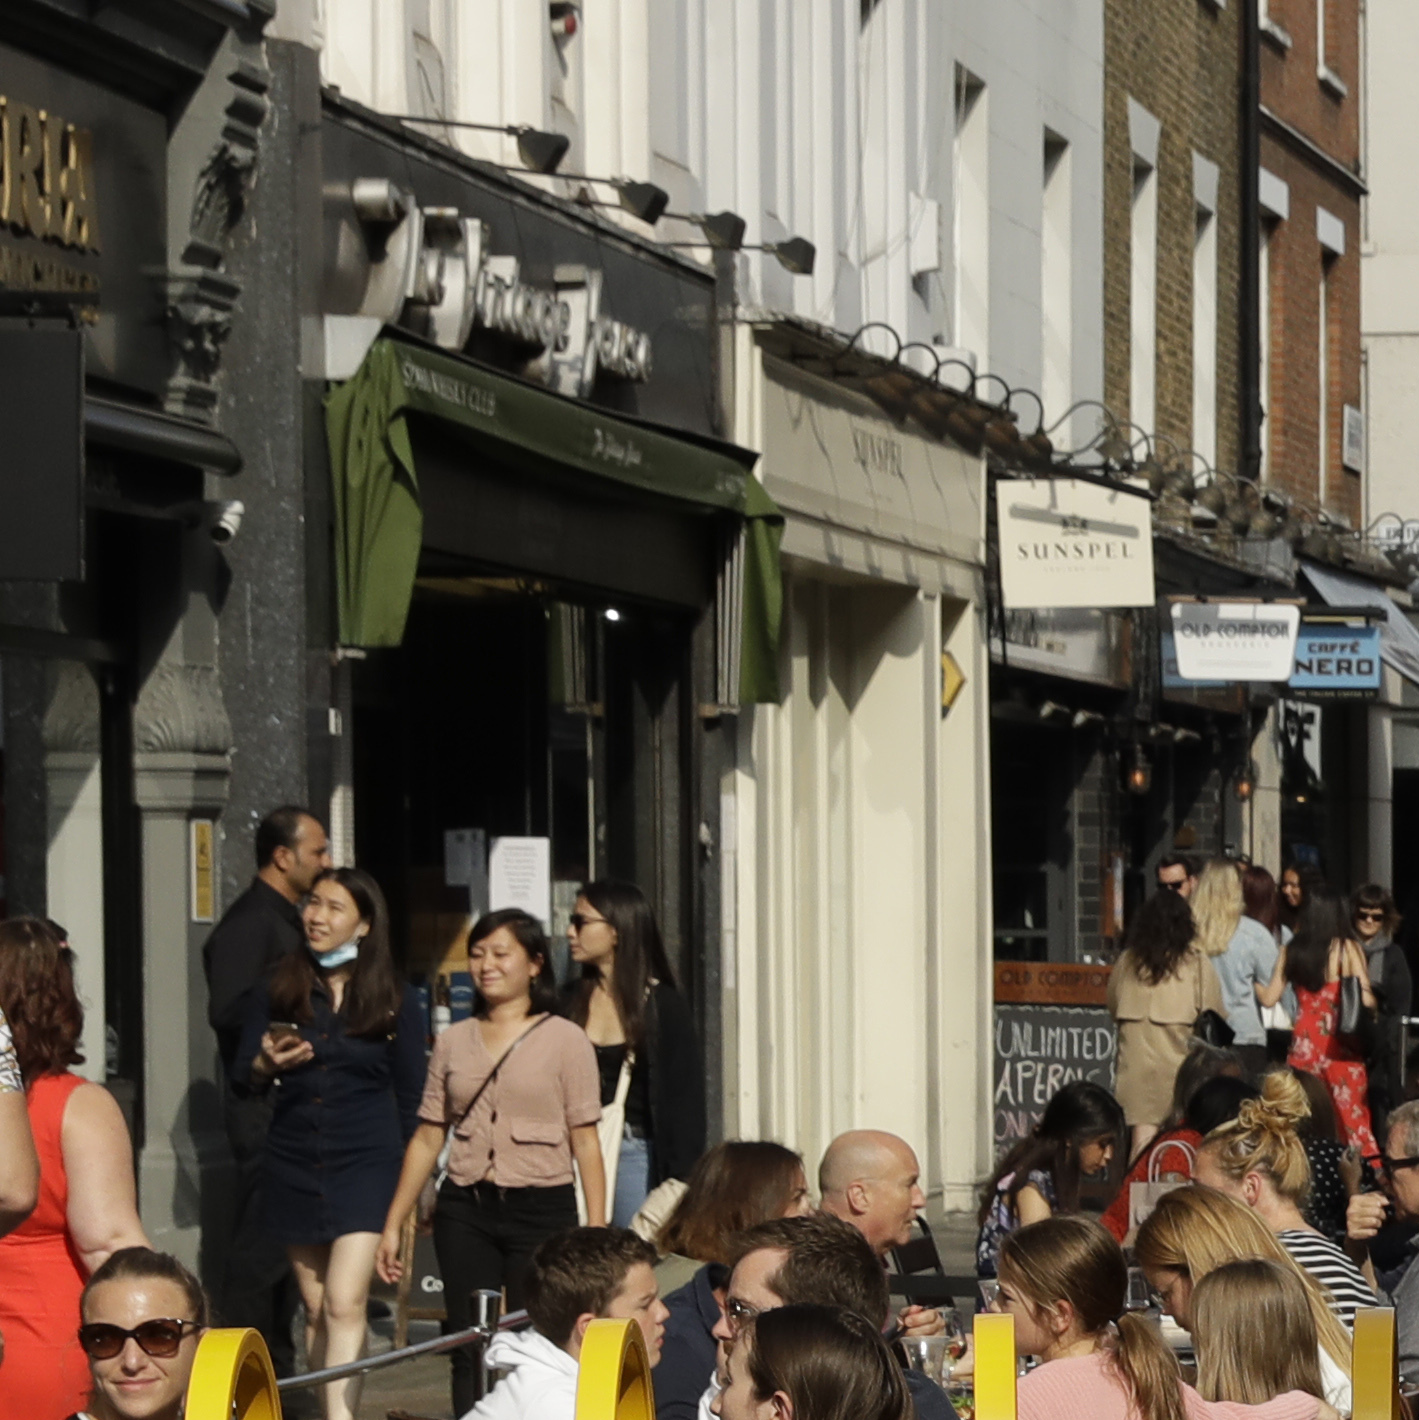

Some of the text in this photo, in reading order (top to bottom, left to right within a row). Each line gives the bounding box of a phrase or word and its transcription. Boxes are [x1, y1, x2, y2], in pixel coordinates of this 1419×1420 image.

[1017, 541, 1134, 560] SUNSPEL
[1181, 621, 1290, 639] OLD COMPTON
[1295, 658, 1374, 676] NERO
[1001, 970, 1033, 985] OLD
[996, 1019, 1113, 1061] UNLIMITED
